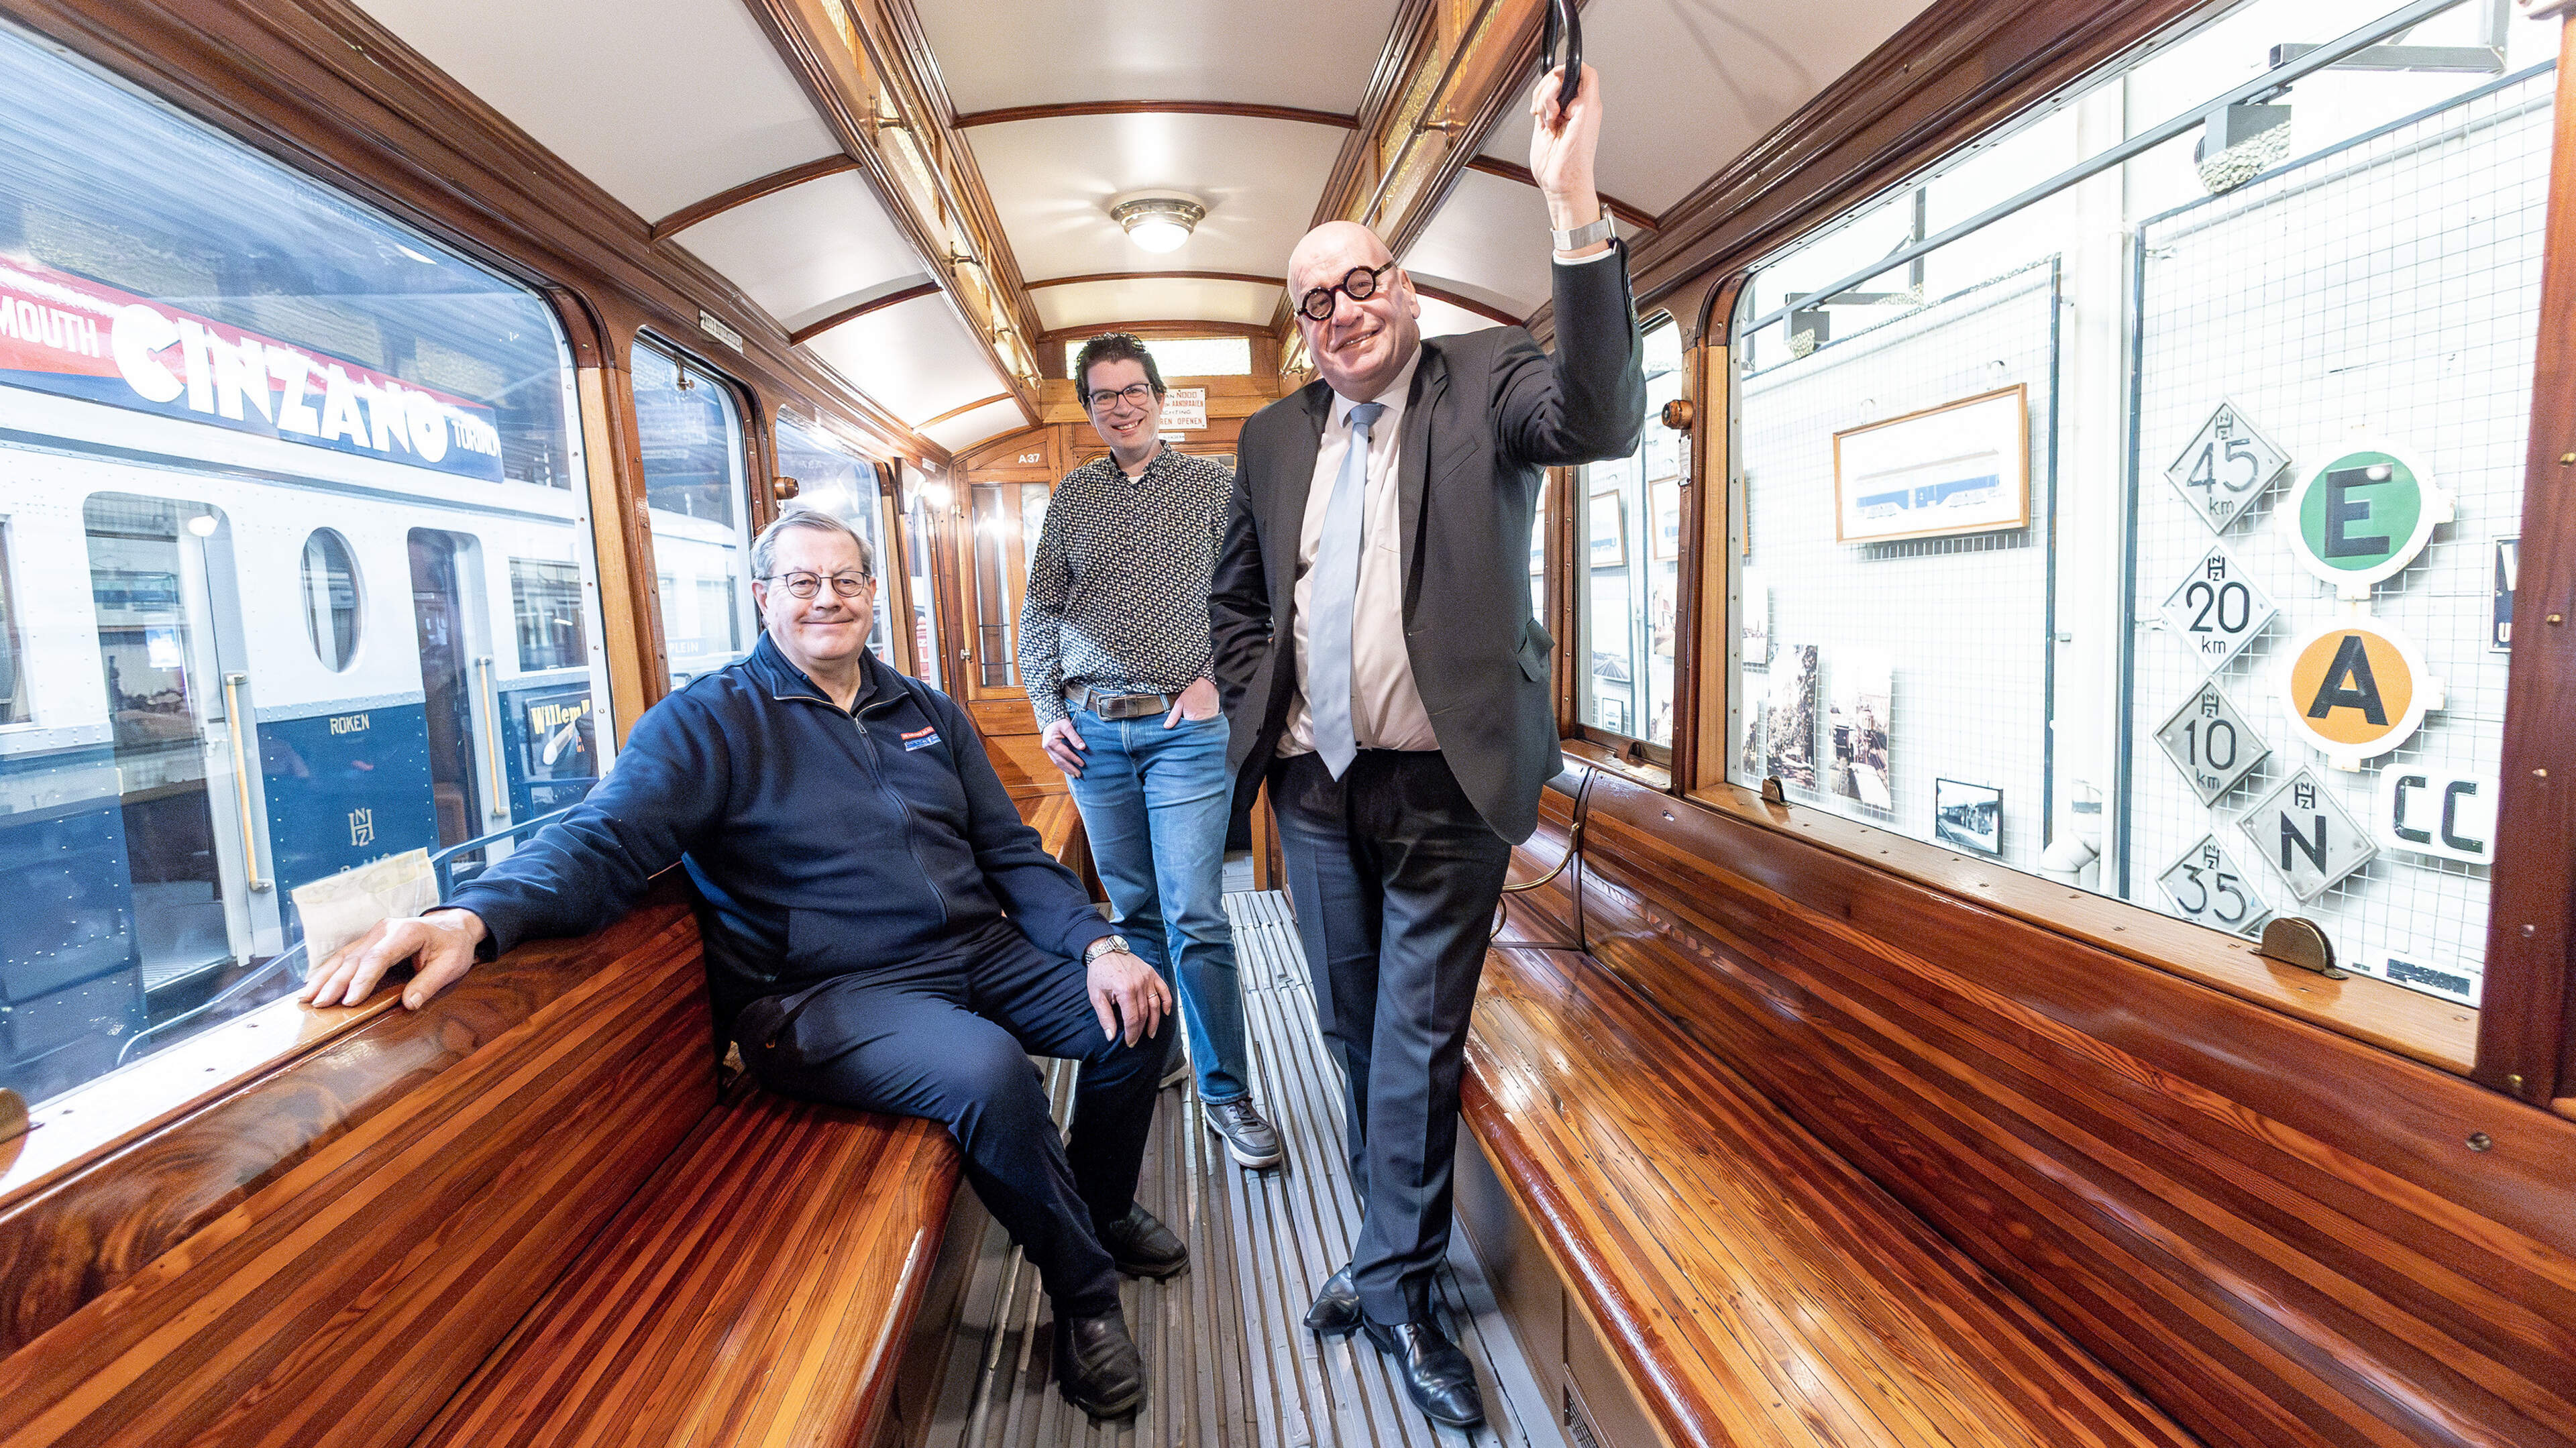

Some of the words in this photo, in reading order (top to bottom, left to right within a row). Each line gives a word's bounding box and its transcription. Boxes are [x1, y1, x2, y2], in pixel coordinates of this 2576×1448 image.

[111, 303, 448, 463] CINZANO
[450, 419, 498, 457] TORINO
[1177, 417, 1202, 425] OPENEN
[1018, 453, 1040, 464] A37
[2187, 437, 2259, 495] 45
[2209, 496, 2235, 516] km
[2324, 463, 2394, 558] E
[2186, 581, 2251, 634] 20
[2202, 635, 2226, 654] km
[2307, 635, 2390, 726] A
[329, 714, 370, 736] ROKEN
[2184, 719, 2237, 771] 10
[2196, 767, 2220, 790] km
[2393, 775, 2485, 854] CC
[2280, 810, 2327, 878] N
[2177, 862, 2247, 925] 35
